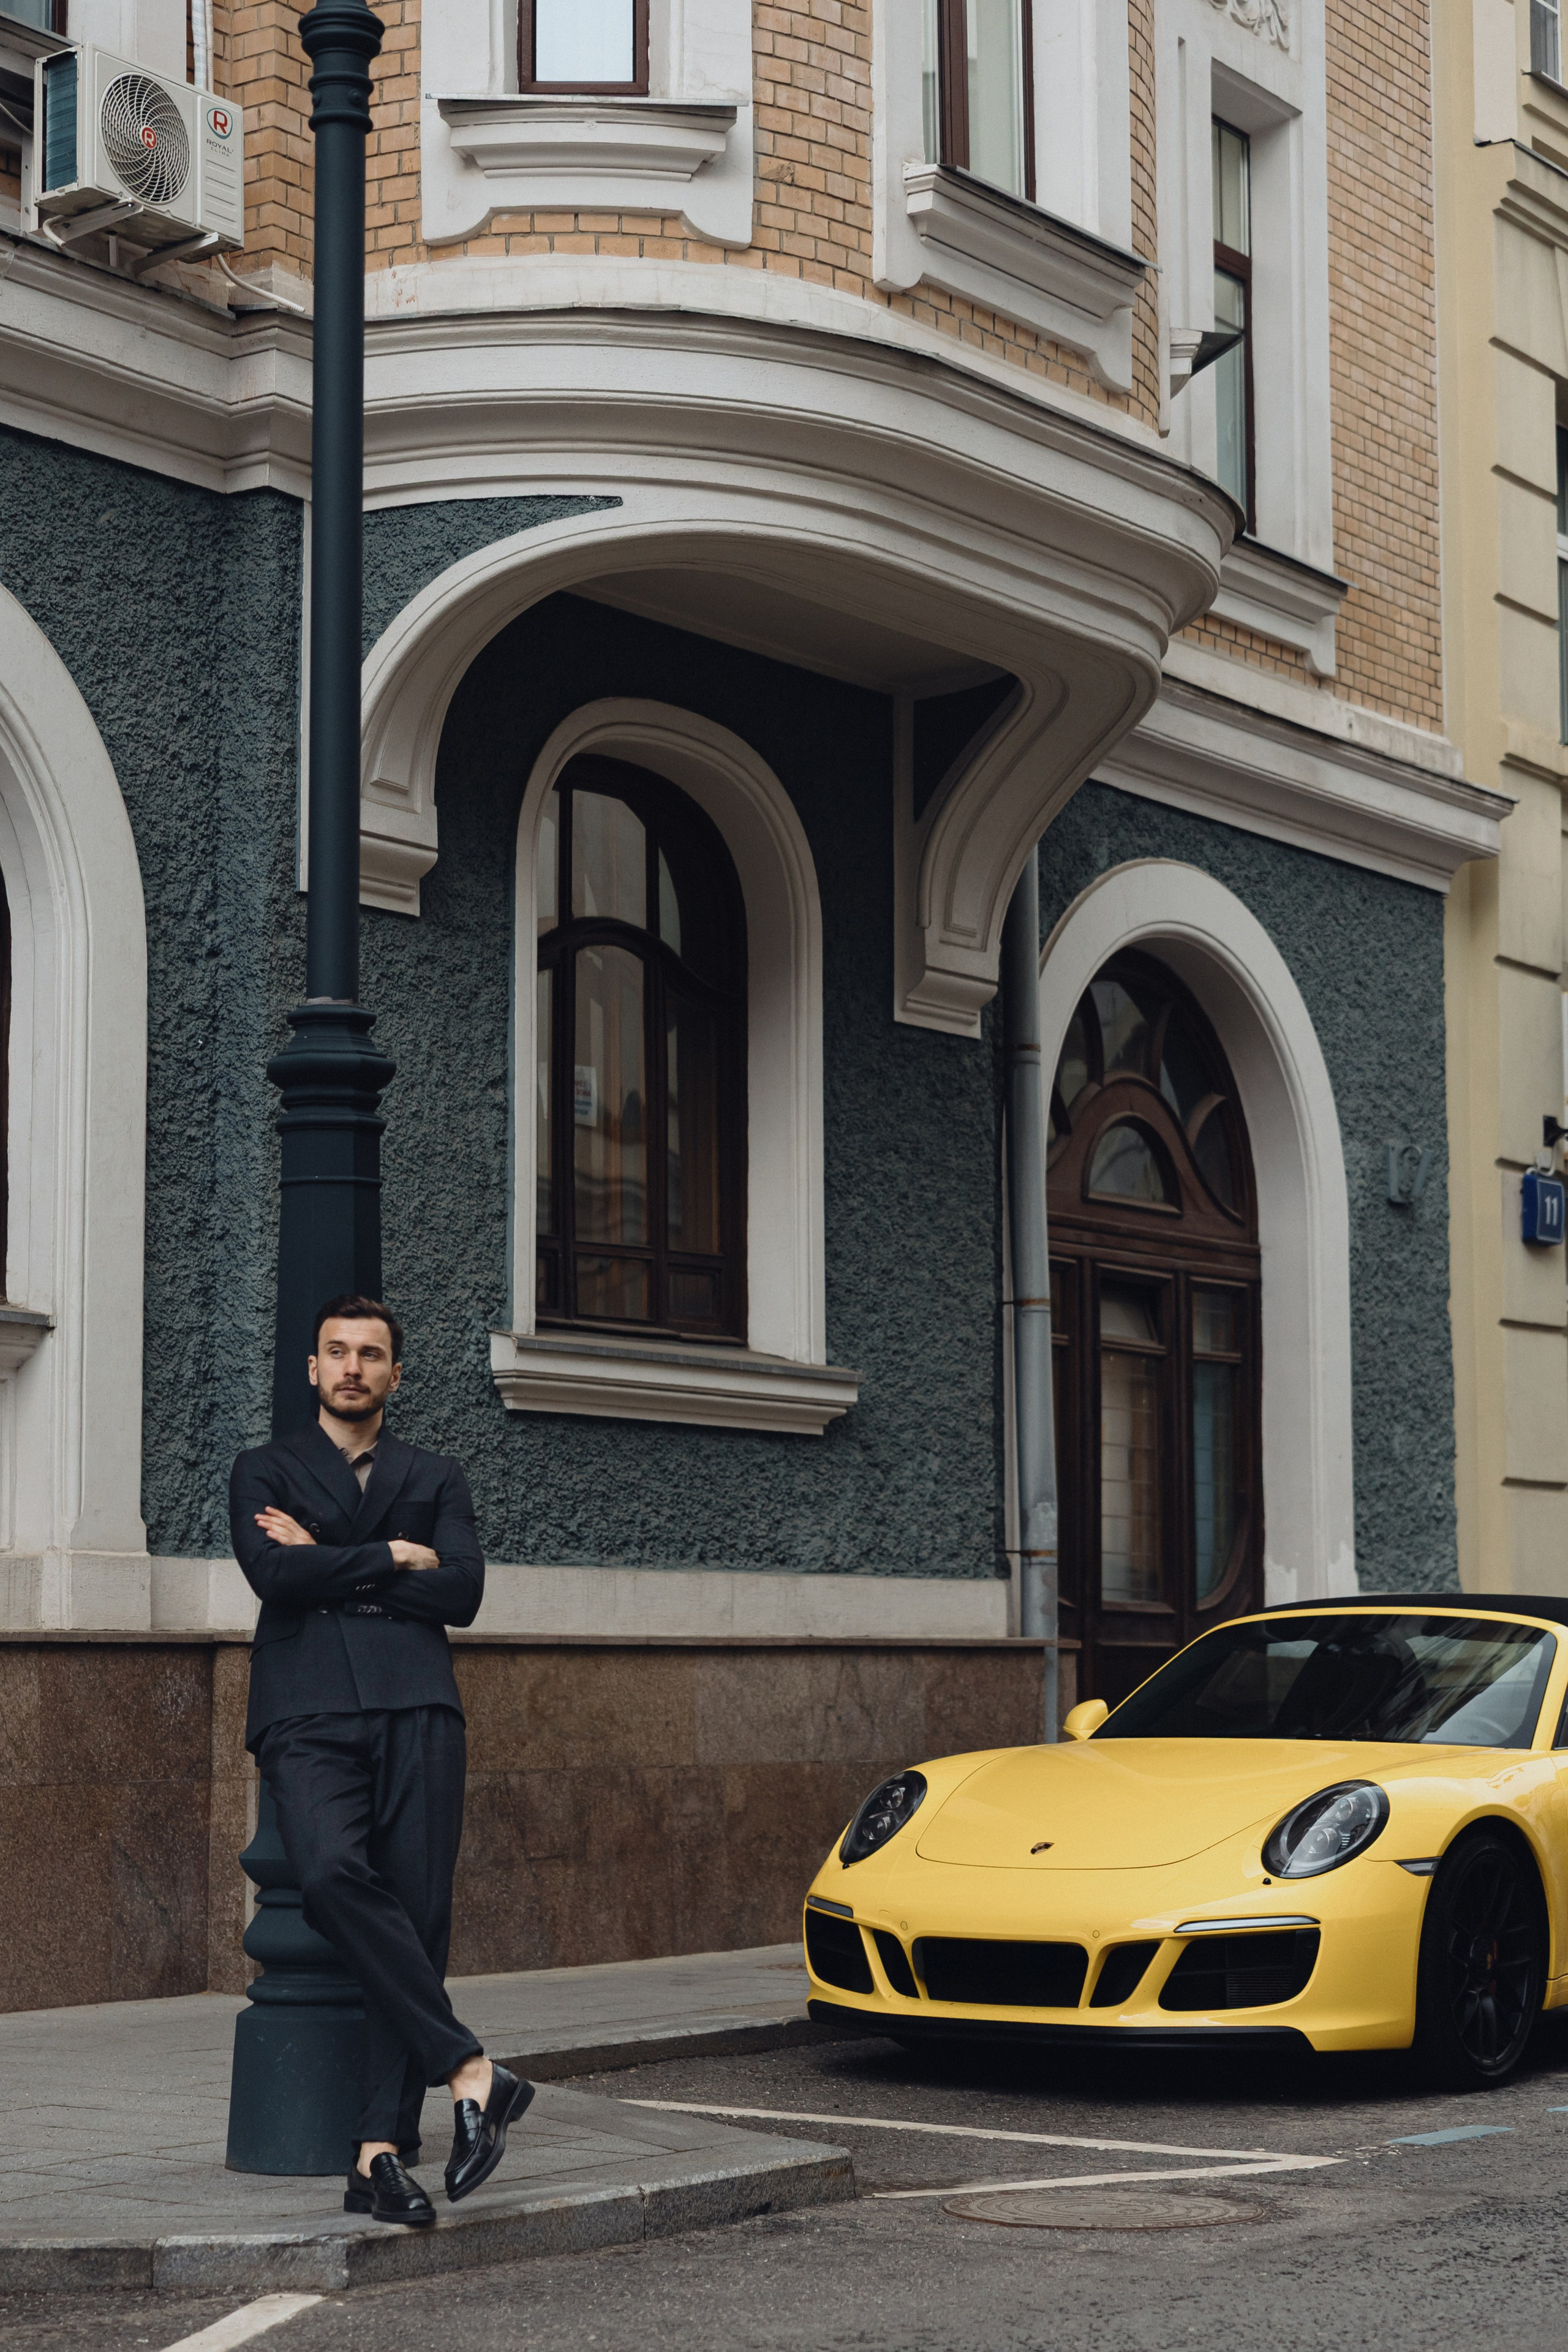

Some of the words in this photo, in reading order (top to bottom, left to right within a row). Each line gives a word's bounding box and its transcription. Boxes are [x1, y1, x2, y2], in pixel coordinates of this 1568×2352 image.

[213, 110, 228, 134] R
[144, 130, 154, 146] R
[1545, 1195, 1558, 1226] 11
